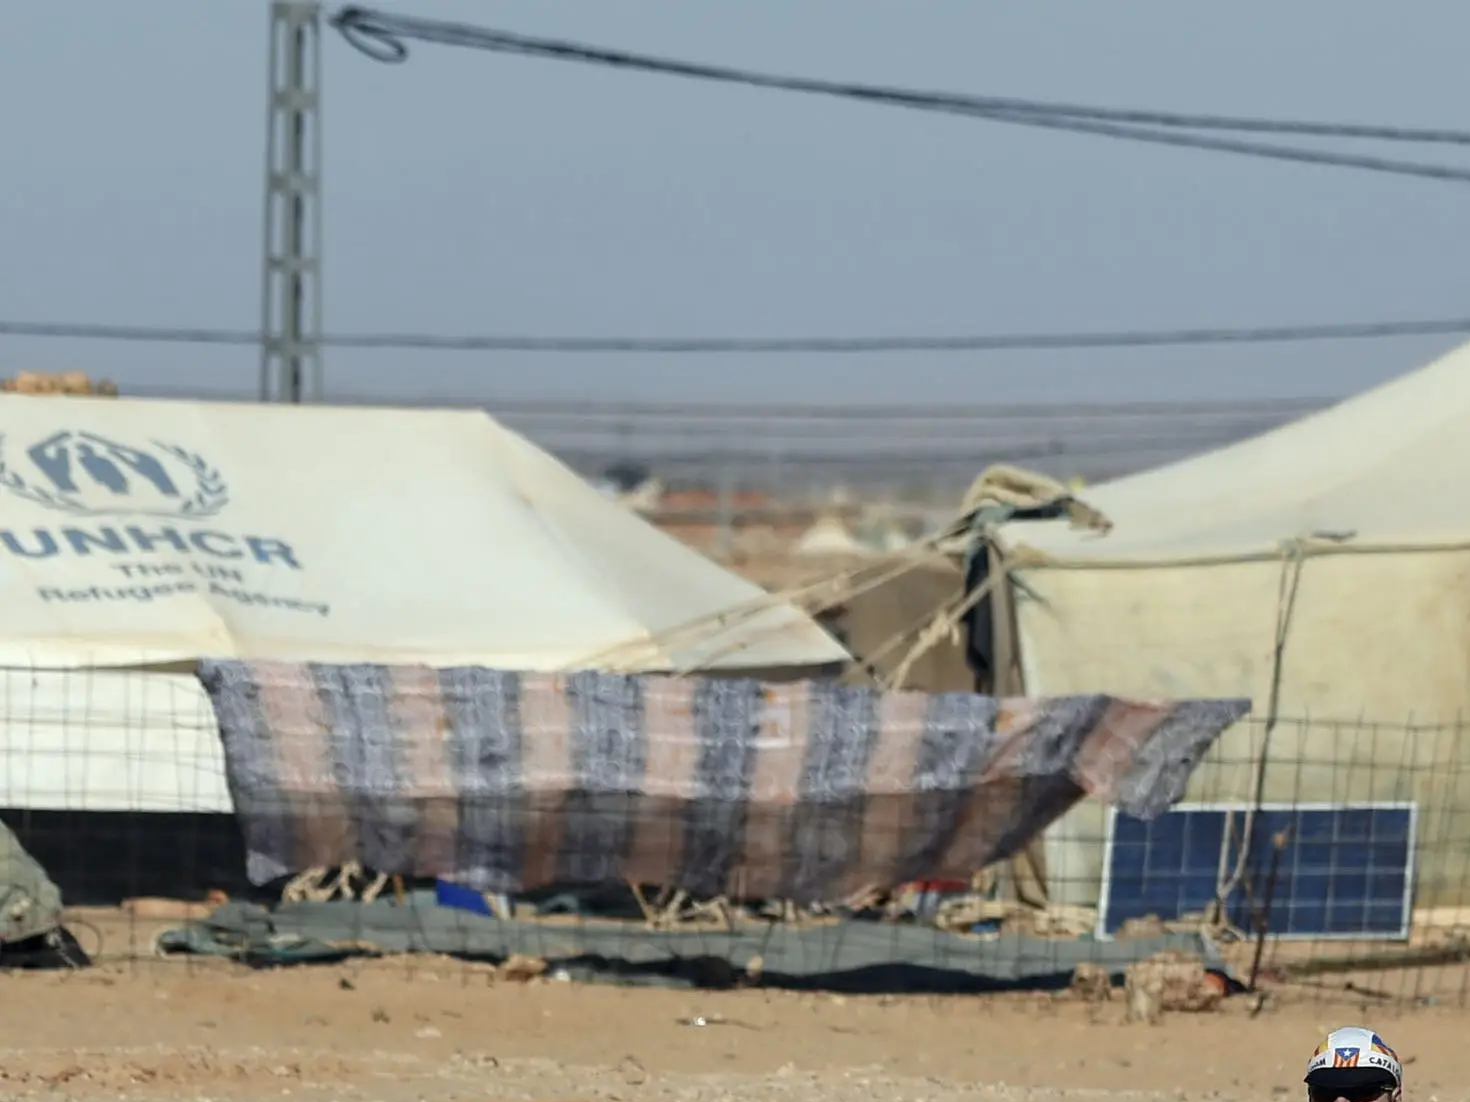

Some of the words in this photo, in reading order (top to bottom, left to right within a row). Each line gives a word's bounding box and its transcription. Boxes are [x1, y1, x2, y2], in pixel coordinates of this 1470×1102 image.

[0, 526, 303, 570] UNHCR
[110, 563, 183, 578] The
[190, 562, 243, 583] UN
[37, 580, 197, 602] Refugee
[208, 582, 331, 617] Agency
